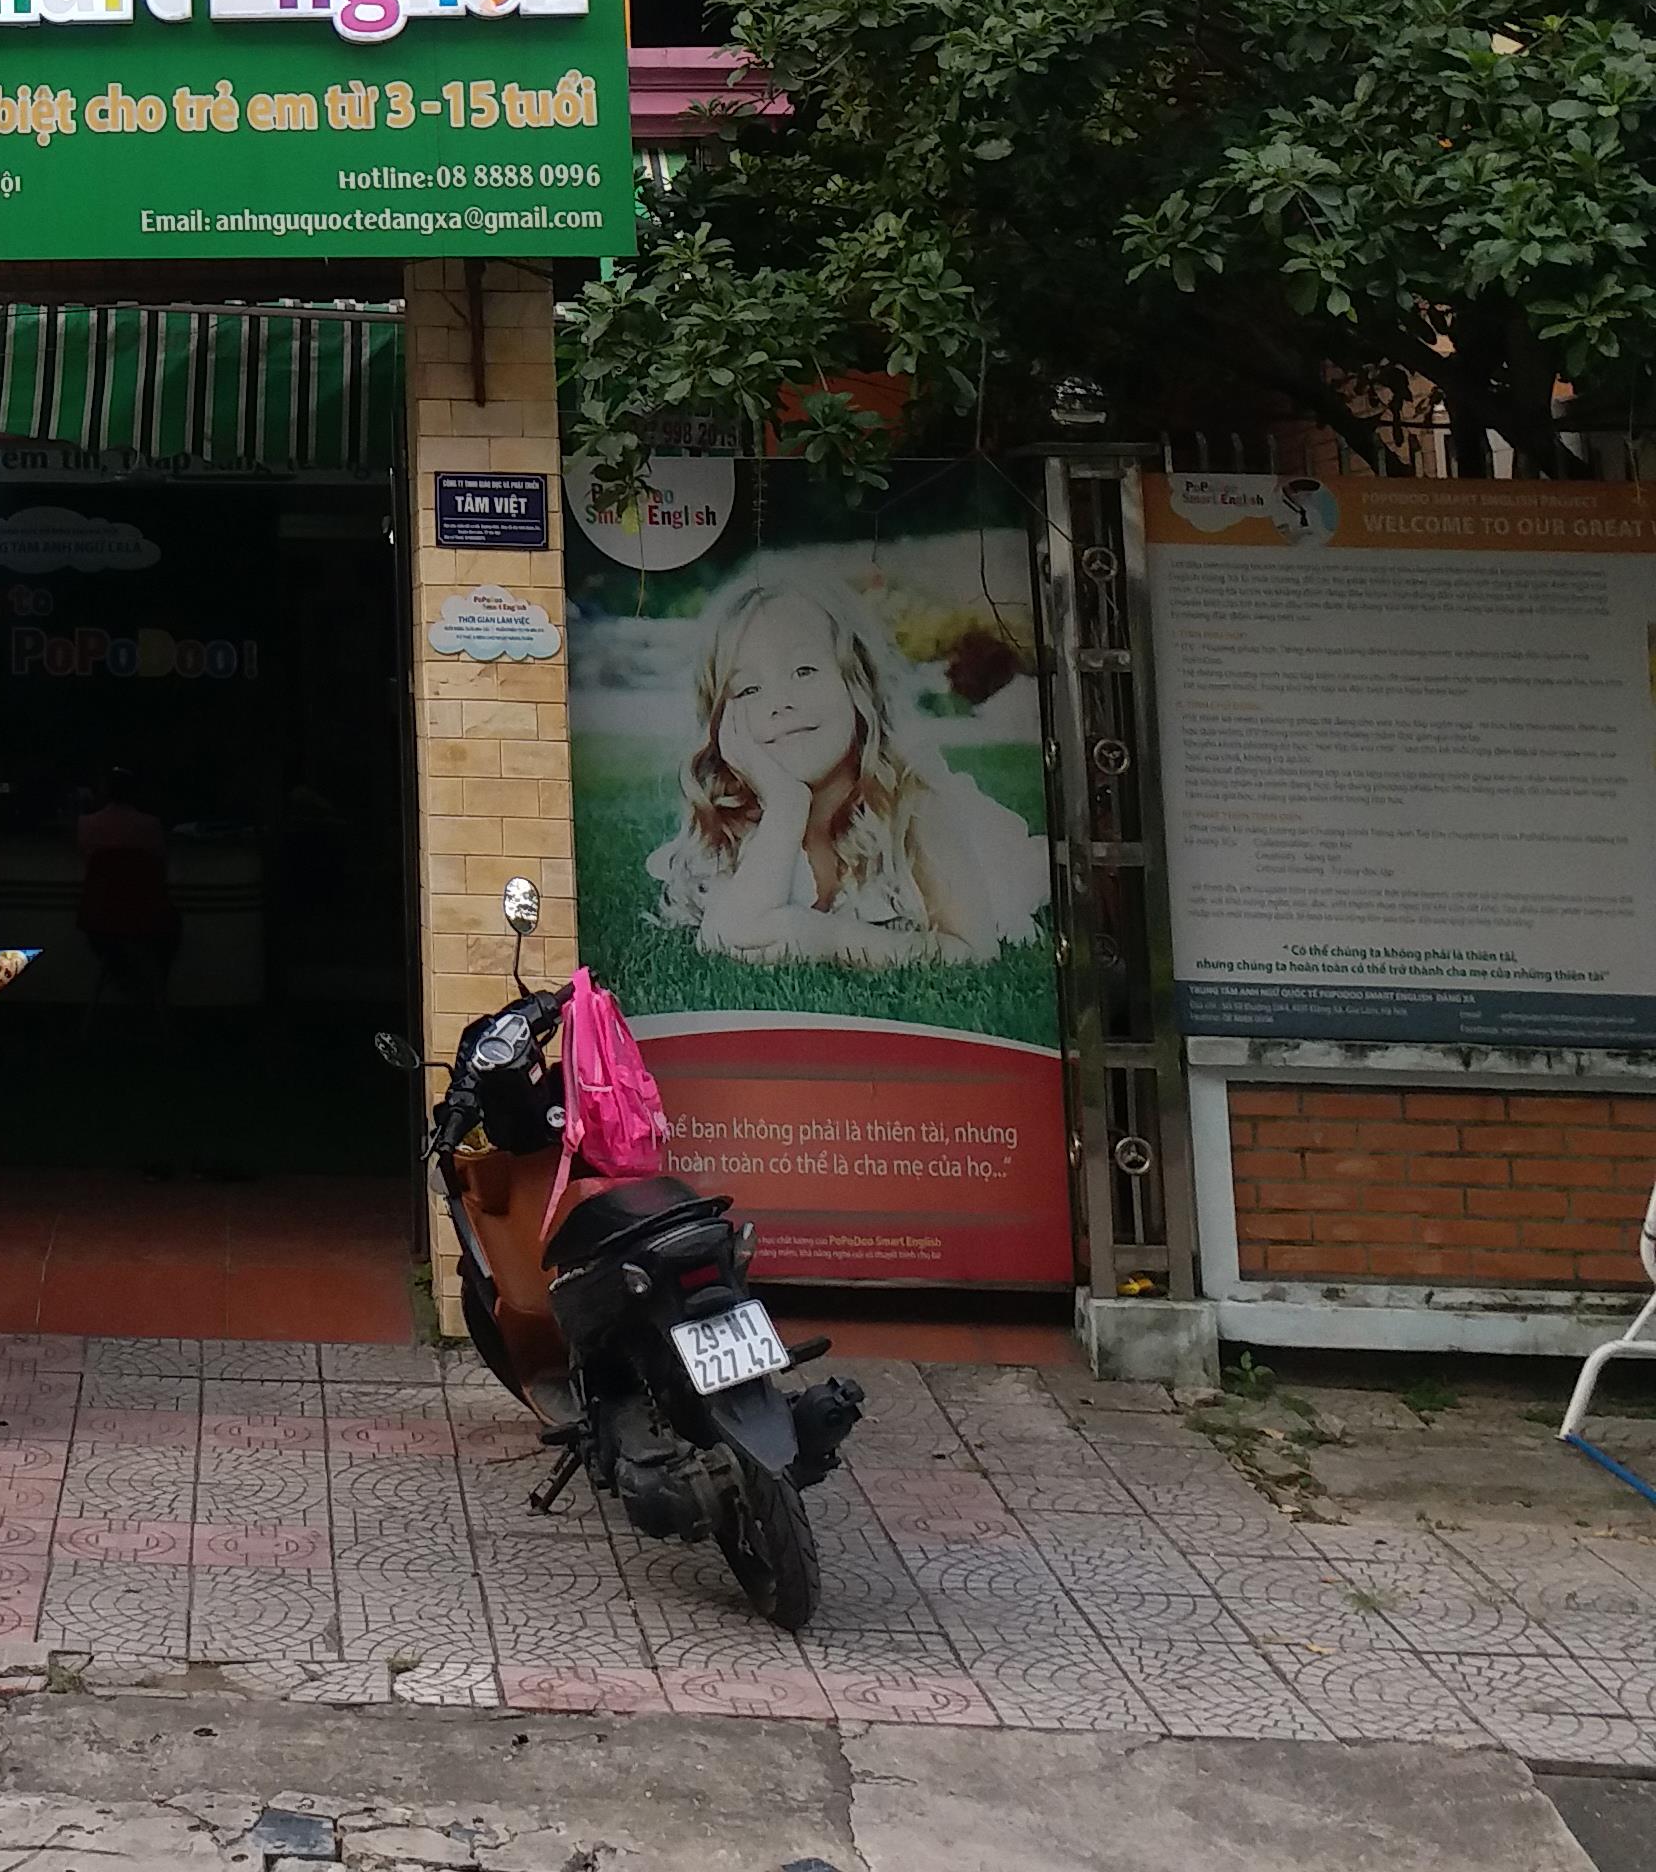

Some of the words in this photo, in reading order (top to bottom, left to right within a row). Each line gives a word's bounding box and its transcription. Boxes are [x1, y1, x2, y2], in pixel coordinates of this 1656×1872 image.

[85, 81, 170, 134] cho
[174, 78, 239, 131] trẻ
[246, 88, 320, 131] em
[325, 79, 379, 130] từ
[502, 68, 598, 129] tuổi
[338, 166, 434, 190] Hotline:
[436, 164, 467, 188] 08
[473, 164, 534, 188] 8888
[539, 163, 602, 187] 0996
[140, 208, 212, 233] Email:
[215, 205, 604, 236] anhnguquoctedangxa@gmail.com
[454, 492, 490, 514] TÂM
[493, 493, 528, 518] VIỆT
[1363, 514, 1476, 536] WELCOME
[1481, 517, 1511, 537] TO
[1517, 517, 1565, 537] OUR
[1573, 518, 1643, 538] GREAT
[691, 1116, 728, 1145] bạn
[732, 1117, 794, 1146] không
[799, 1116, 841, 1146] phải
[844, 1118, 862, 1143] là
[865, 1119, 915, 1144] thiên
[919, 1120, 951, 1147] tài,
[953, 1121, 1018, 1149] nhưng
[667, 1148, 715, 1173] hoàn
[719, 1149, 765, 1174] toàn
[769, 1151, 792, 1175] có
[795, 1148, 829, 1176] thể
[832, 1152, 849, 1176] là
[853, 1153, 888, 1177] cha
[892, 1158, 924, 1181] mẹ
[928, 1154, 962, 1178] của
[687, 1309, 759, 1356] 29-N1
[694, 1336, 782, 1389] 227.42
